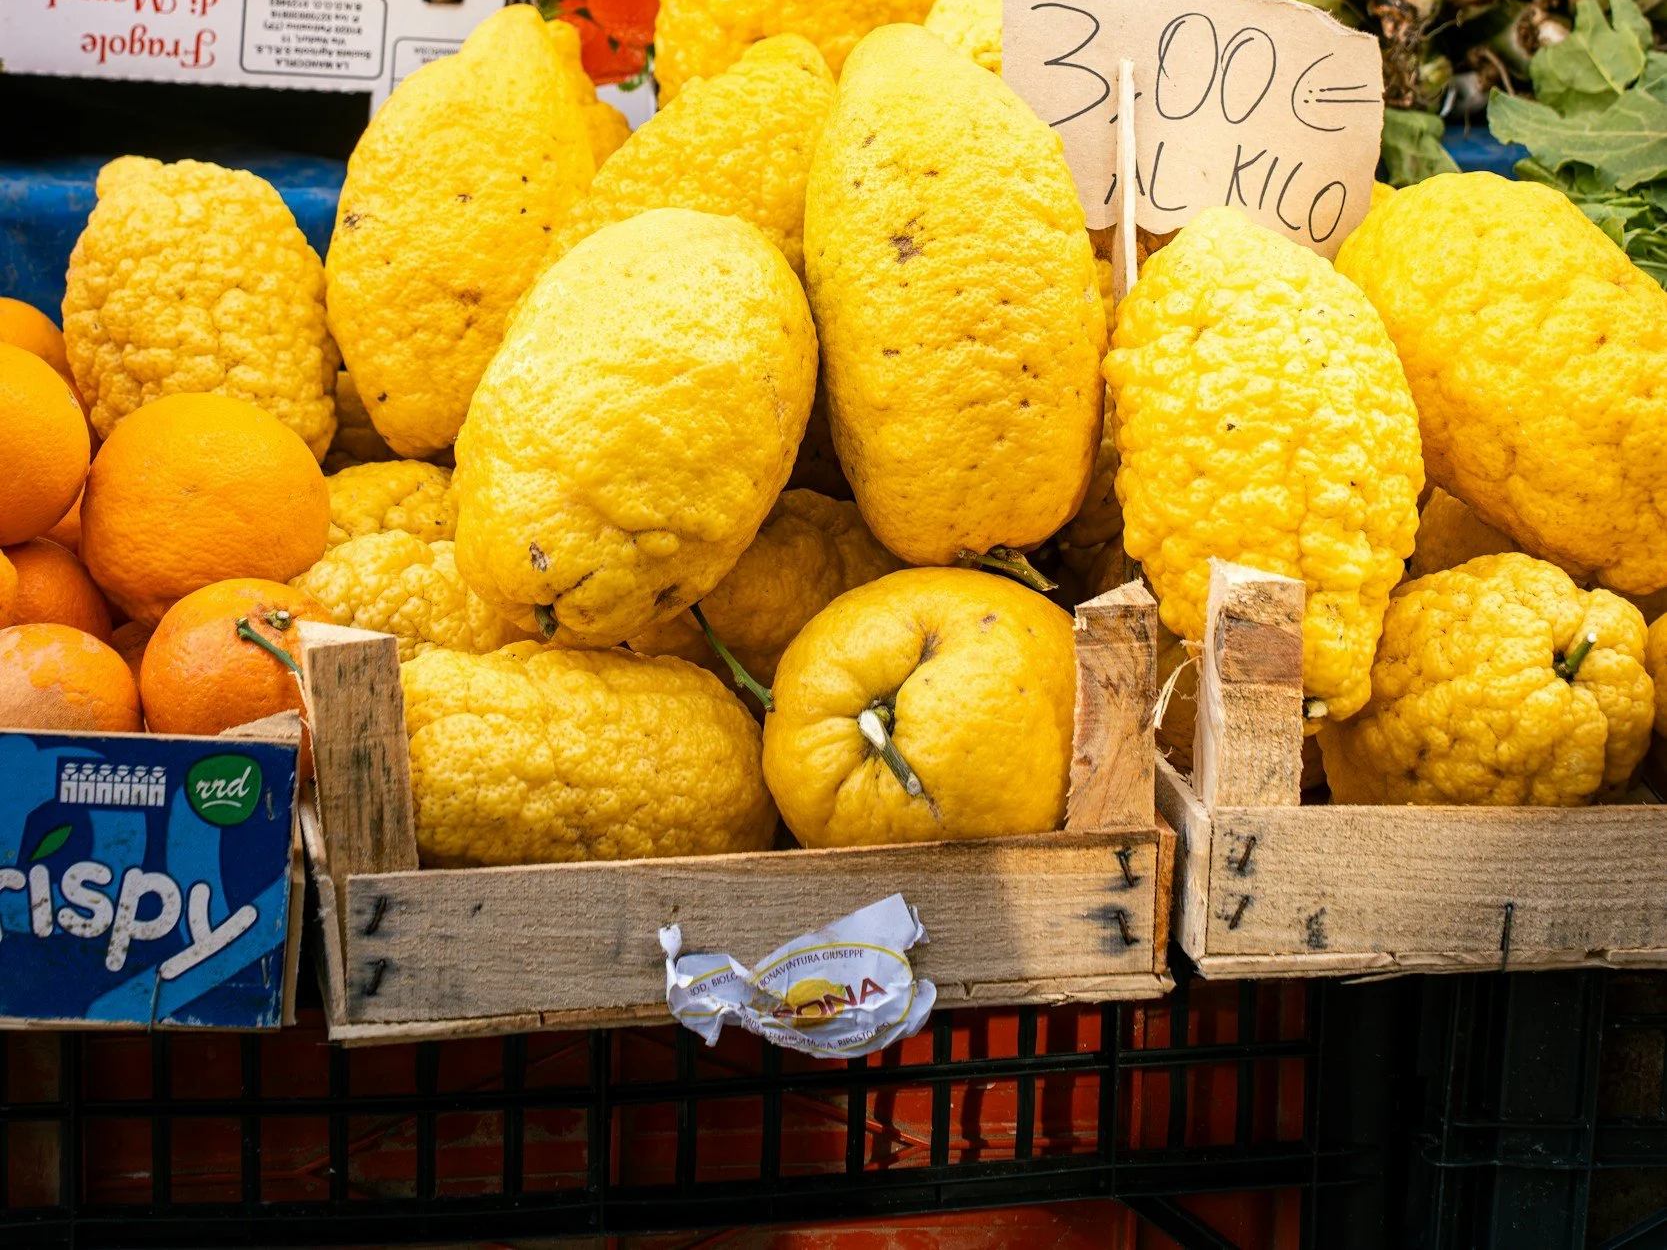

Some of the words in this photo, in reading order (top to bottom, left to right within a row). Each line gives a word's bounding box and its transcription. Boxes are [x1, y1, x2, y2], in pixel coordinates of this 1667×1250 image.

[81, 23, 217, 69] Fragole
[333, 61, 350, 70] LA
[1225, 144, 1347, 243] KILO
[760, 953, 820, 987] BONAVENTURA
[822, 949, 865, 961] GIUSEPPE
[838, 1030, 874, 1047] RIPOSTO
